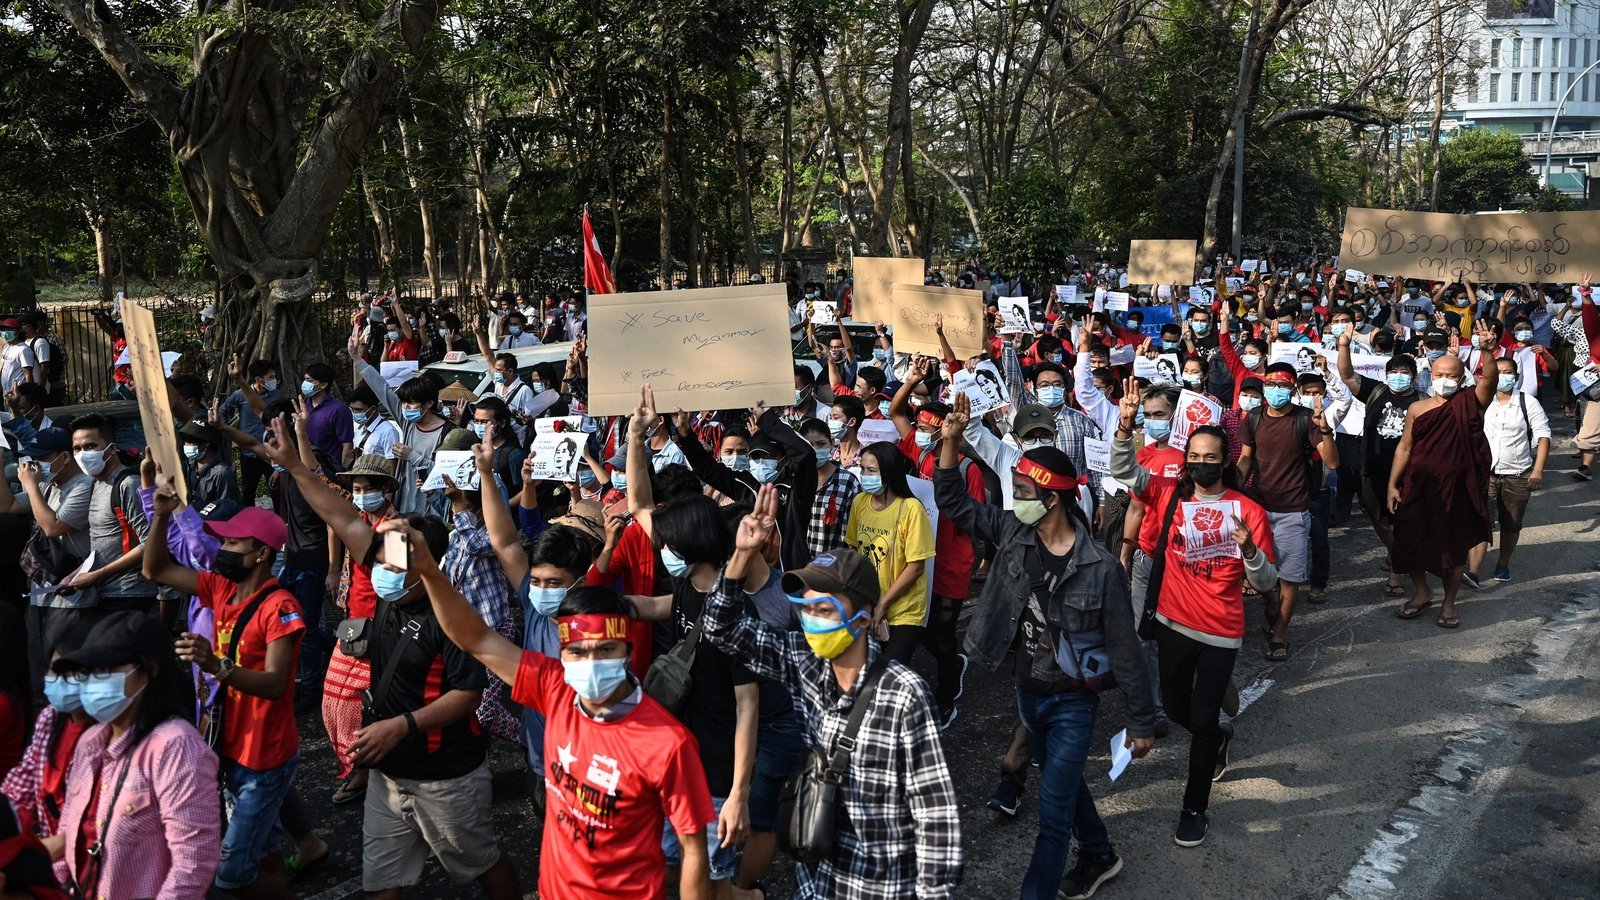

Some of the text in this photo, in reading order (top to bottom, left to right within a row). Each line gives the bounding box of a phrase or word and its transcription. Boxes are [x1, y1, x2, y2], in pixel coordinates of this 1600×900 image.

[652, 310, 710, 328] Save
[682, 328, 767, 350] Myanmar
[641, 368, 674, 380] Free
[1028, 466, 1052, 486] NLD
[605, 618, 626, 638] NLD
